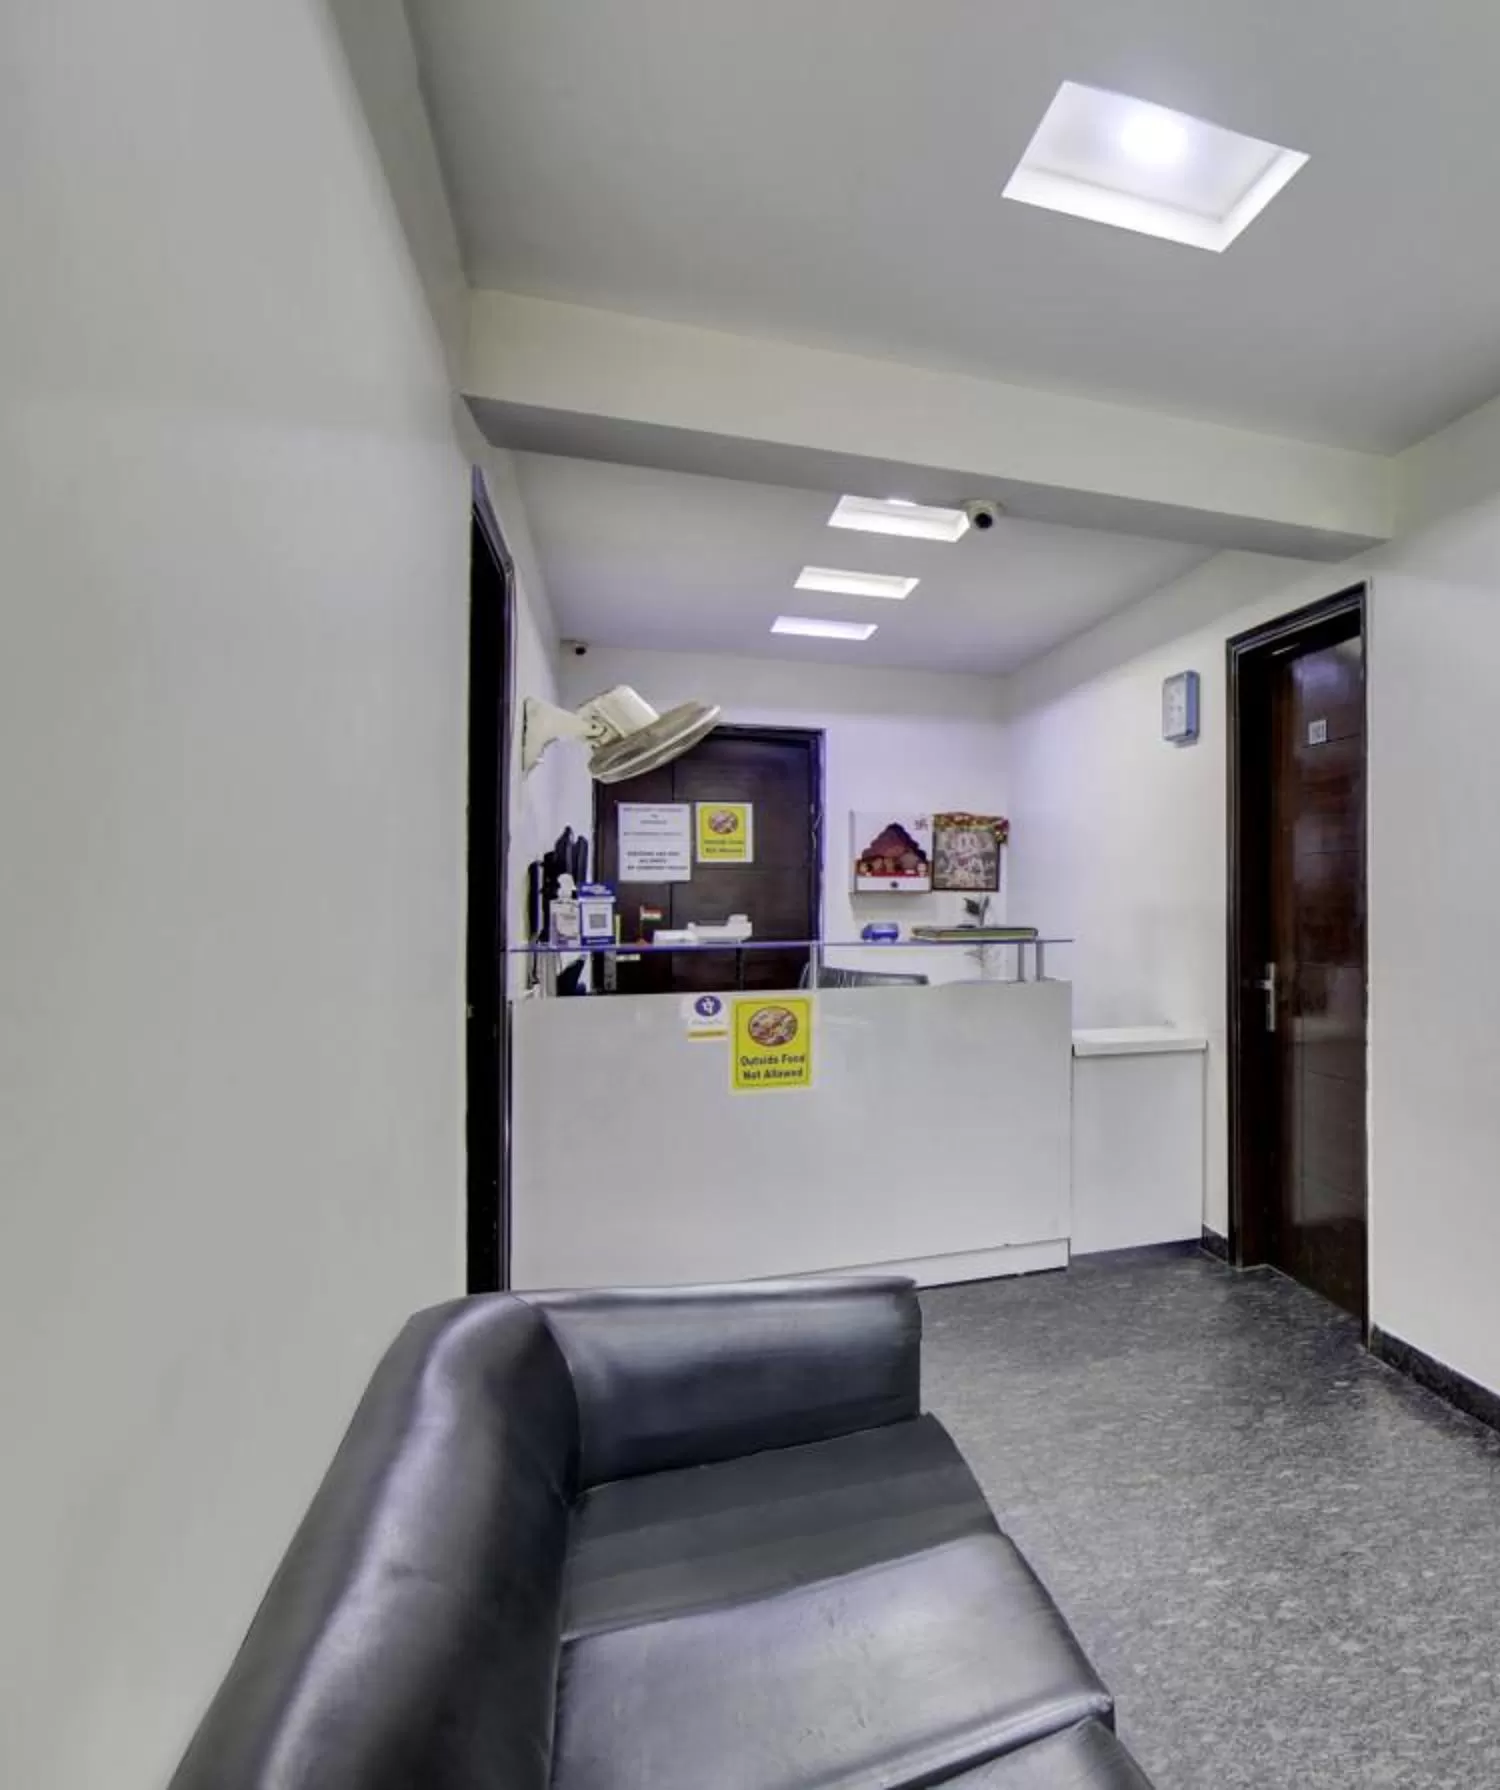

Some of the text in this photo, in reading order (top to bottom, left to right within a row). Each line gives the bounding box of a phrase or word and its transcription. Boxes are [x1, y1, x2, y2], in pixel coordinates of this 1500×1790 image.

[740, 1055, 779, 1067] Outside
[743, 1068, 803, 1080] Not Allowed
